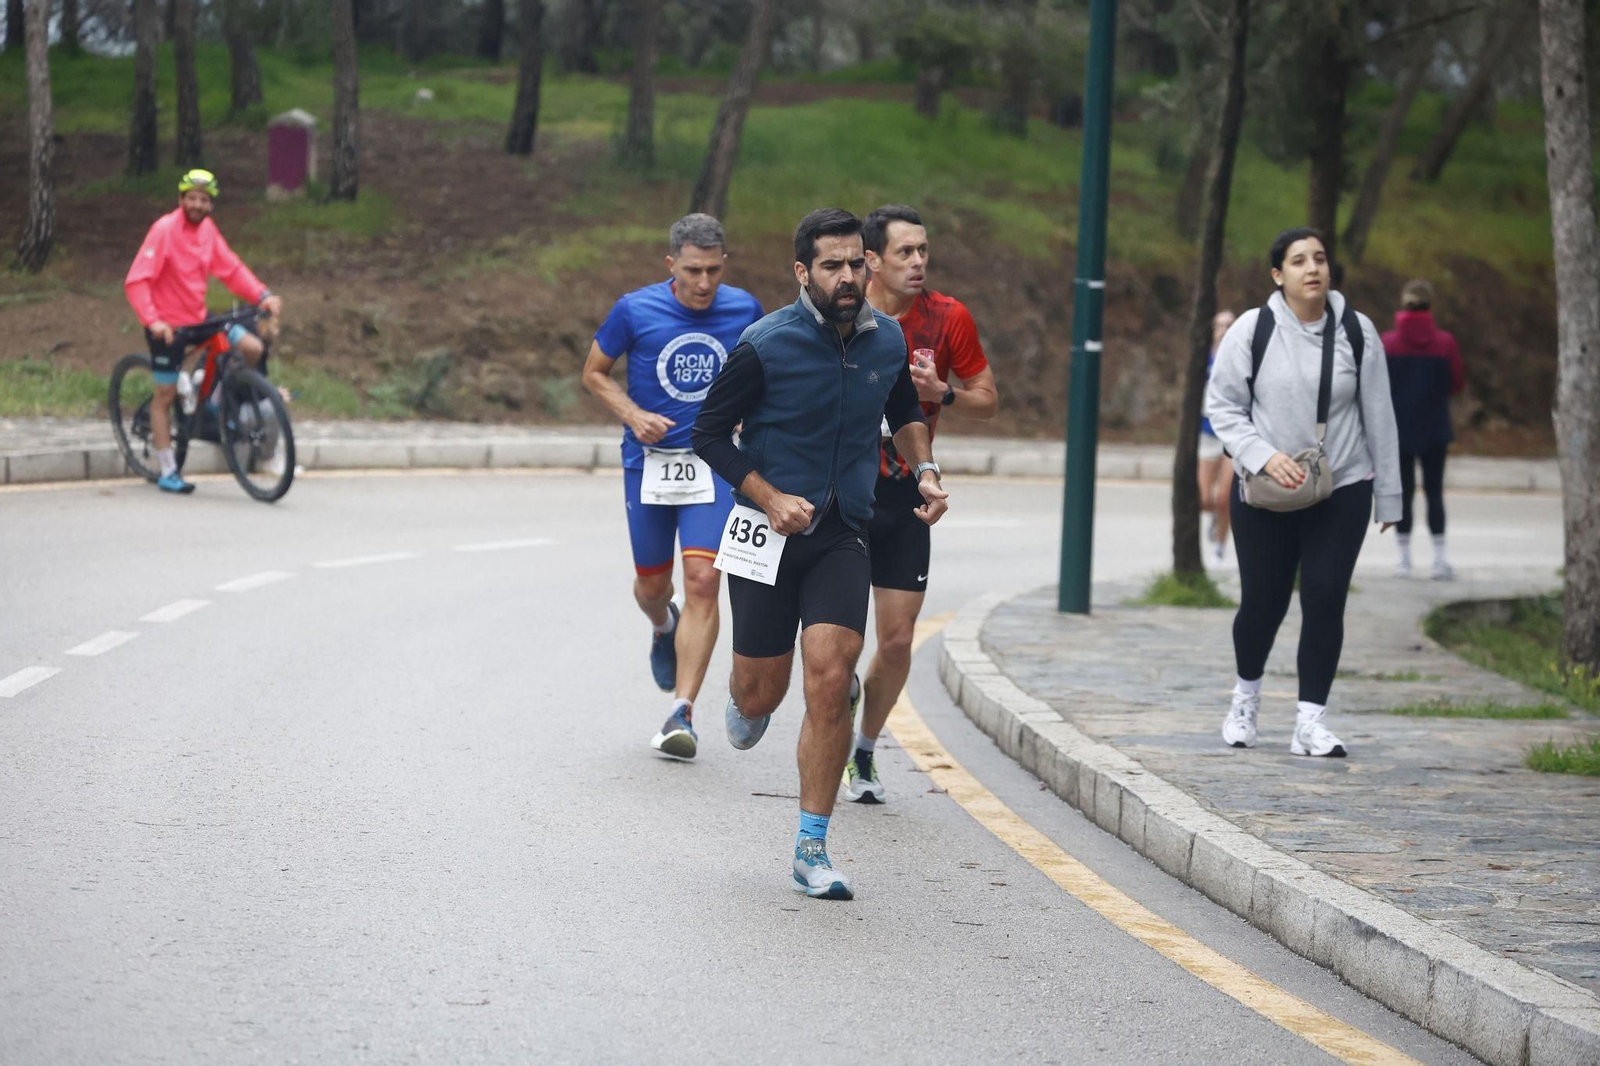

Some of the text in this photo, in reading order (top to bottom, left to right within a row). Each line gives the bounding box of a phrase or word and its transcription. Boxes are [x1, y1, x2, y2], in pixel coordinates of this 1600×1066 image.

[674, 354, 715, 368] RCM
[673, 368, 713, 382] 1873
[661, 463, 696, 481] 120
[729, 516, 769, 548] 436
